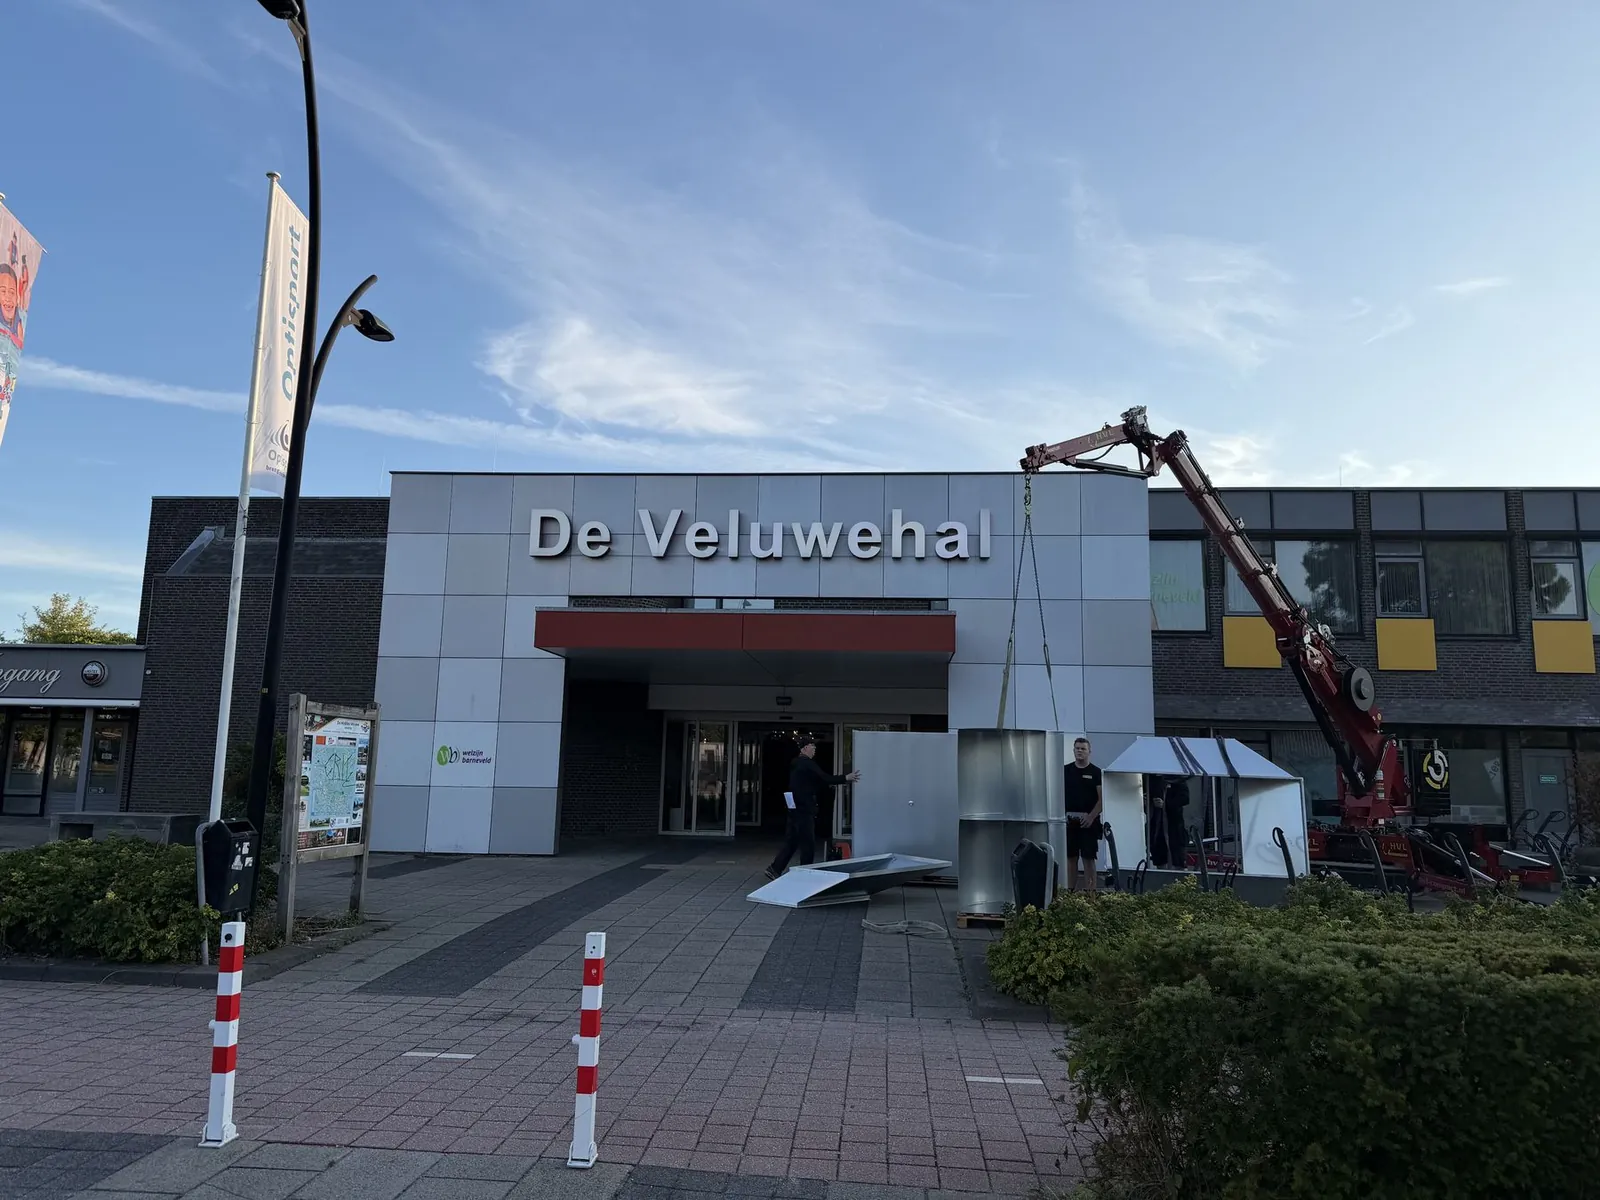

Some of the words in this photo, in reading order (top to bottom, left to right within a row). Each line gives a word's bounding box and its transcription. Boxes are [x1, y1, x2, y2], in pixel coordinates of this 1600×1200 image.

[282, 225, 300, 401] Optisport
[529, 508, 612, 559] De
[638, 508, 991, 560] Veluwehal
[1390, 842, 1407, 851] HVL
